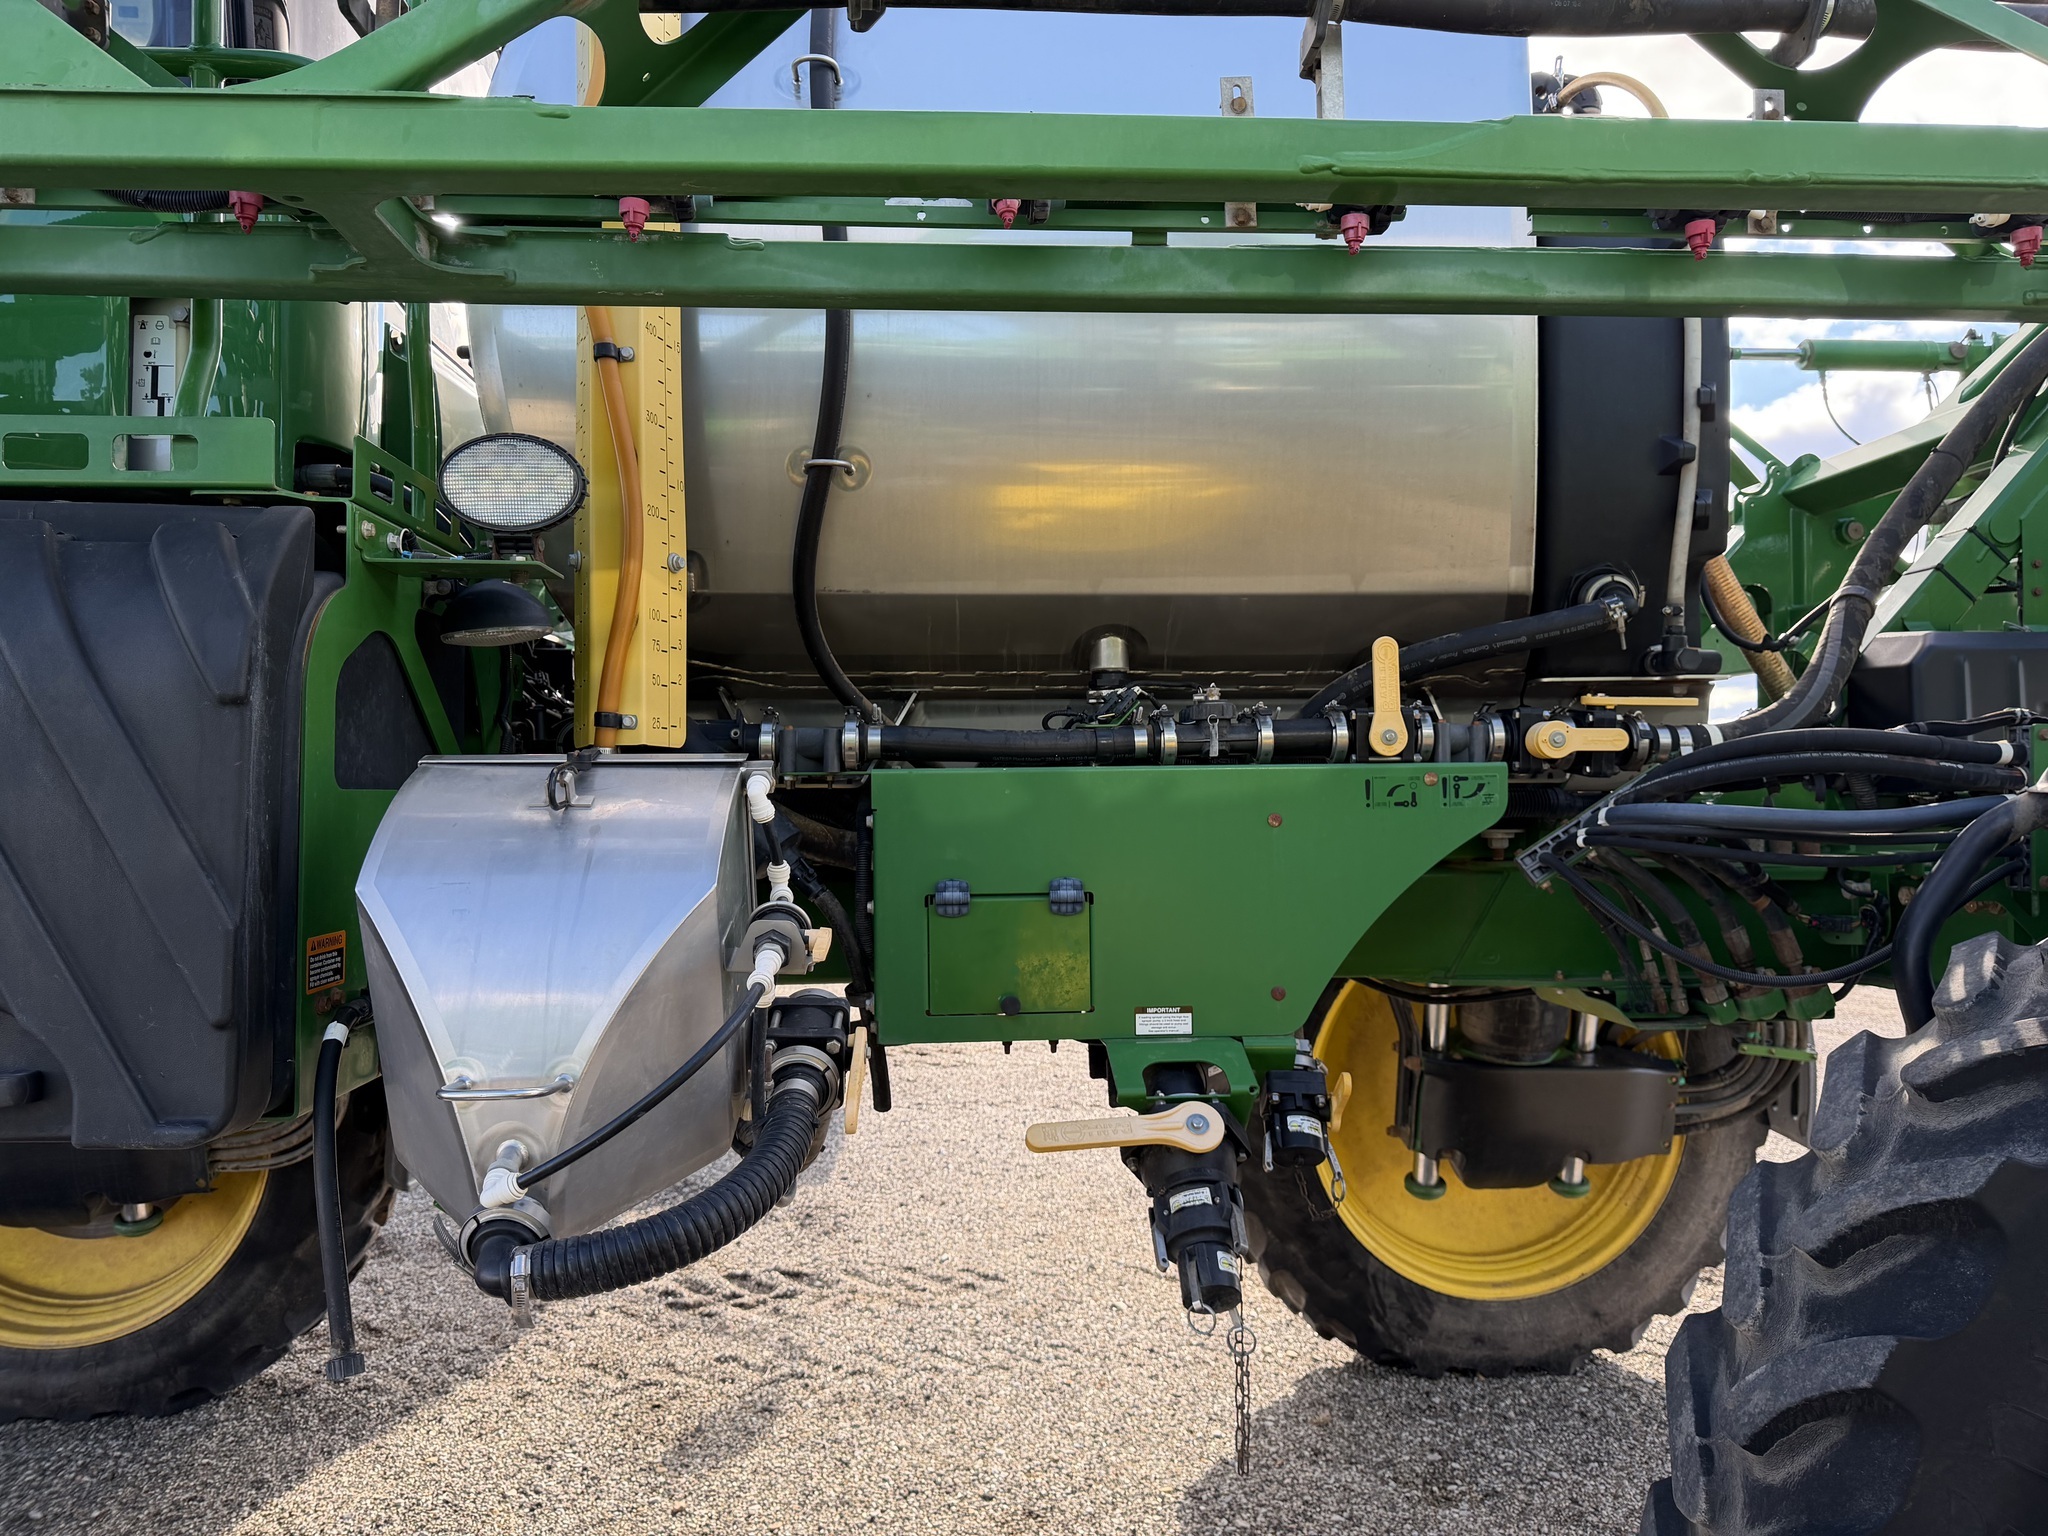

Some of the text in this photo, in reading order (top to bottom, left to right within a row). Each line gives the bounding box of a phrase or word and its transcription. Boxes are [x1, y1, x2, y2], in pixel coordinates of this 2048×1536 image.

[644, 321, 657, 338] 400
[673, 340, 680, 354] 15
[646, 409, 658, 426] 300
[676, 479, 684, 492] 10
[646, 504, 660, 518] 200
[678, 580, 682, 592] 5
[648, 608, 660, 621] 100
[678, 608, 682, 620] 4
[652, 639, 660, 652] 75
[678, 639, 682, 650] 3
[652, 674, 660, 686] 50
[678, 674, 682, 686] 2
[652, 717, 660, 729] 25
[317, 935, 342, 950] WARNING
